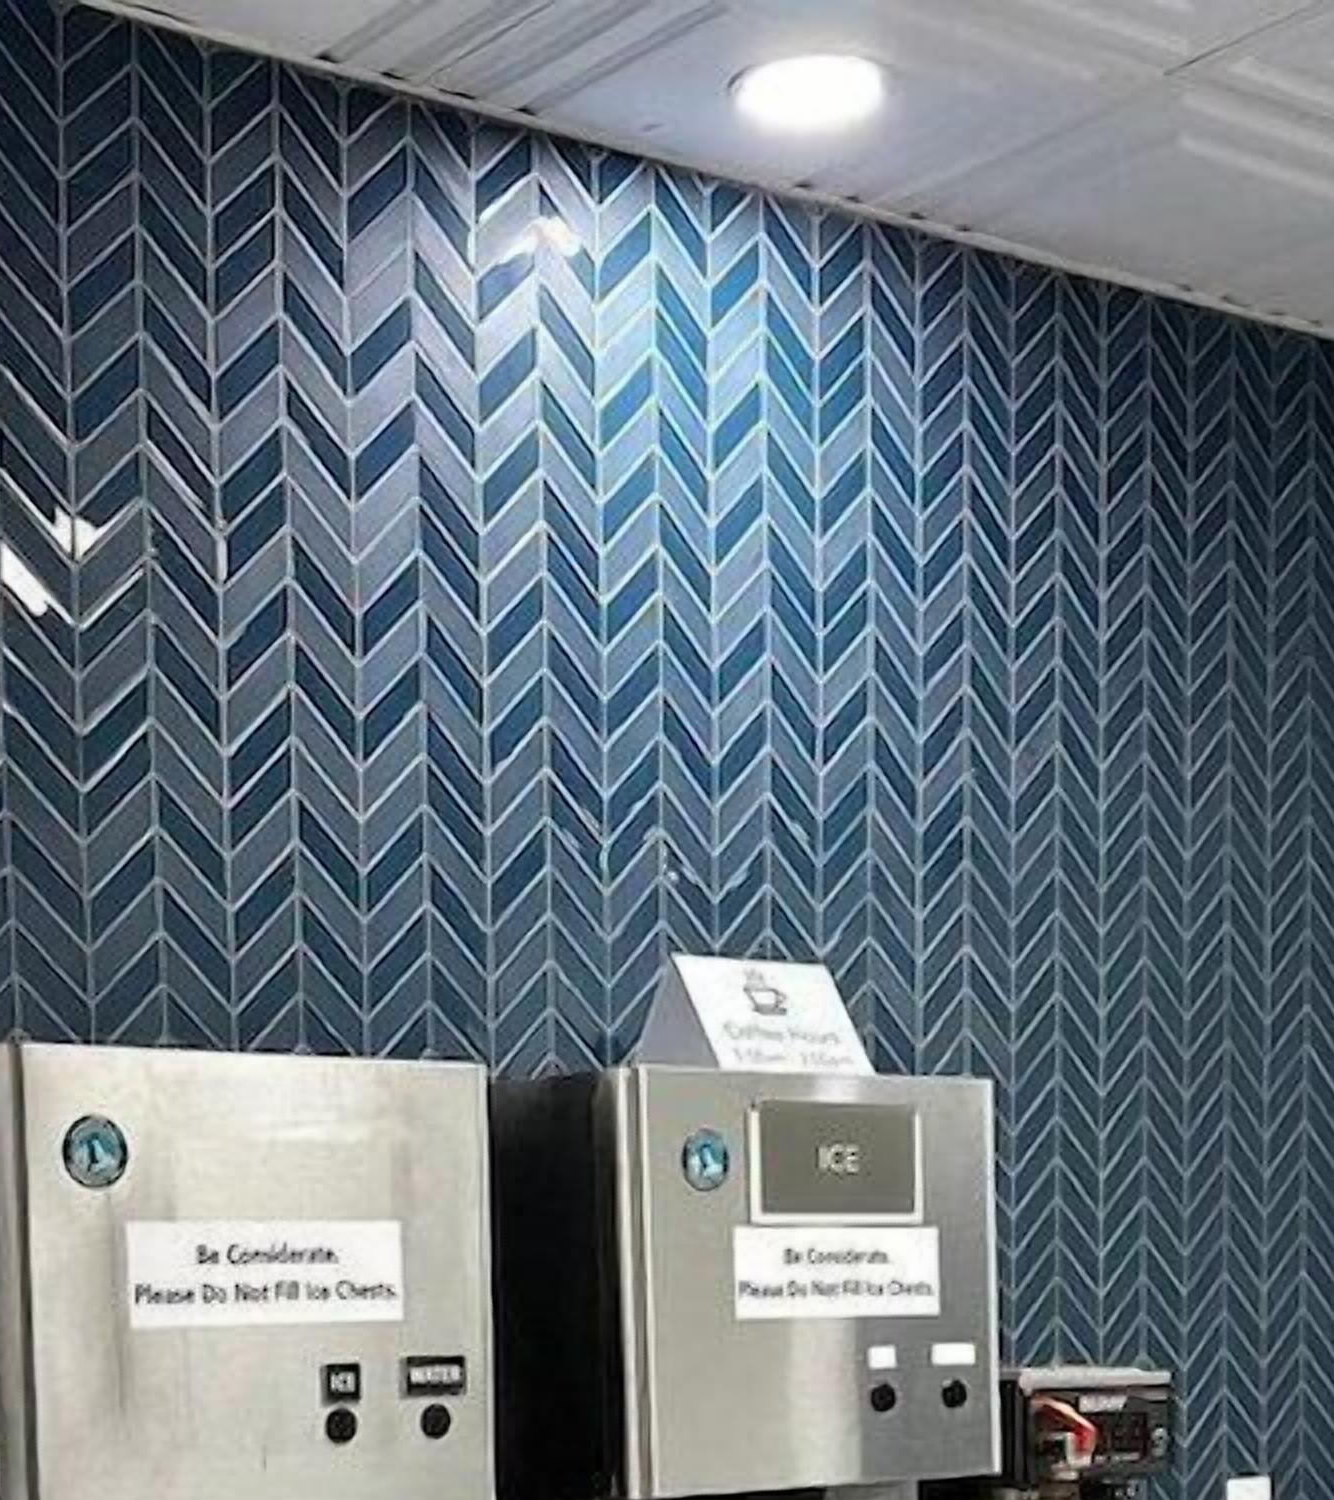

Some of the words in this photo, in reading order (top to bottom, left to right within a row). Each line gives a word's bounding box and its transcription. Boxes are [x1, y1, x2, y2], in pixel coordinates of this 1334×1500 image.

[818, 1144, 860, 1173] ICE
[195, 1244, 220, 1265] Be
[783, 1247, 802, 1265] Be
[134, 1283, 195, 1305] Please
[202, 1283, 228, 1304] Do
[234, 1283, 269, 1303] Not
[274, 1279, 301, 1301] Fill
[304, 1281, 331, 1300] Ice
[738, 1280, 784, 1297] Please
[786, 1280, 808, 1297] Do
[810, 1280, 841, 1297] Not
[841, 1279, 863, 1296] Fill
[330, 1372, 356, 1393] ICE
